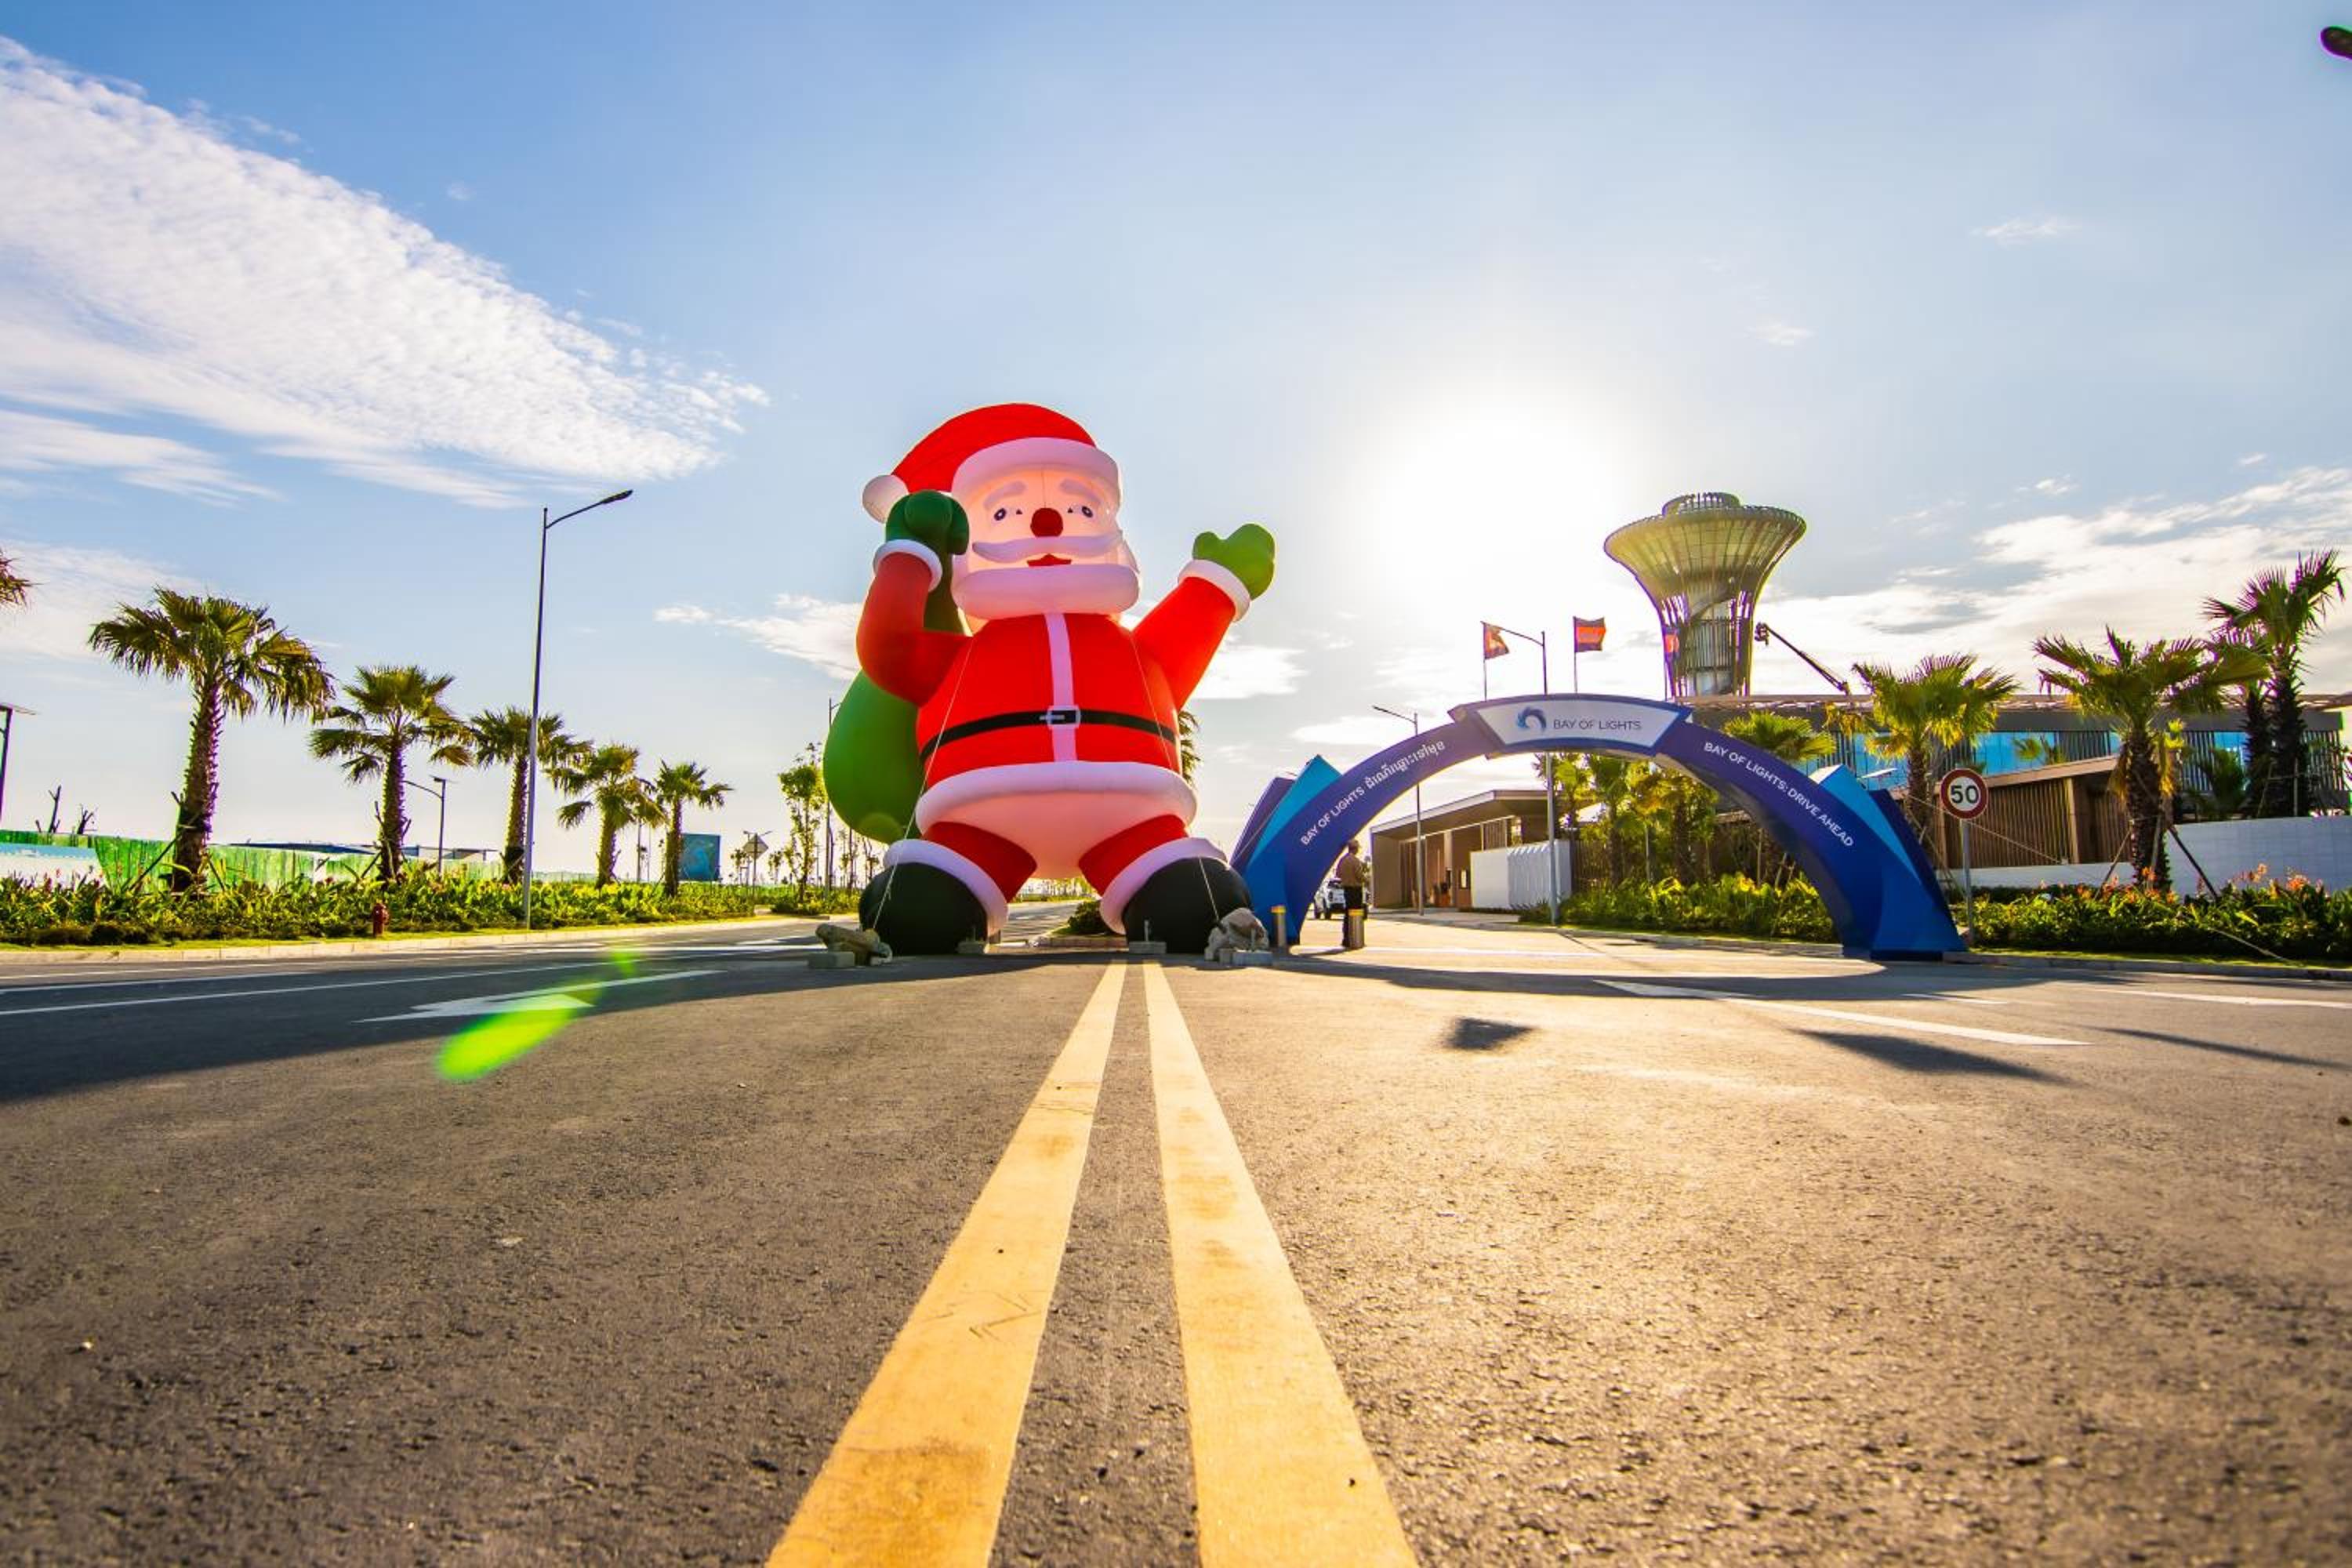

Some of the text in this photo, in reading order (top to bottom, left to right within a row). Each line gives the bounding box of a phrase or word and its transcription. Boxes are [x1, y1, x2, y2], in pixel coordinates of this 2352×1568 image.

[1553, 719, 1642, 730] BAY OF LIGHTS
[1704, 742, 1854, 847] BAY OF LIGHTS: DRIVE AHEAD
[1951, 785, 1979, 804] 50
[1301, 825, 1319, 845] BAY
[1318, 813, 1331, 828] OF
[1332, 786, 1365, 817] LIGHTS
